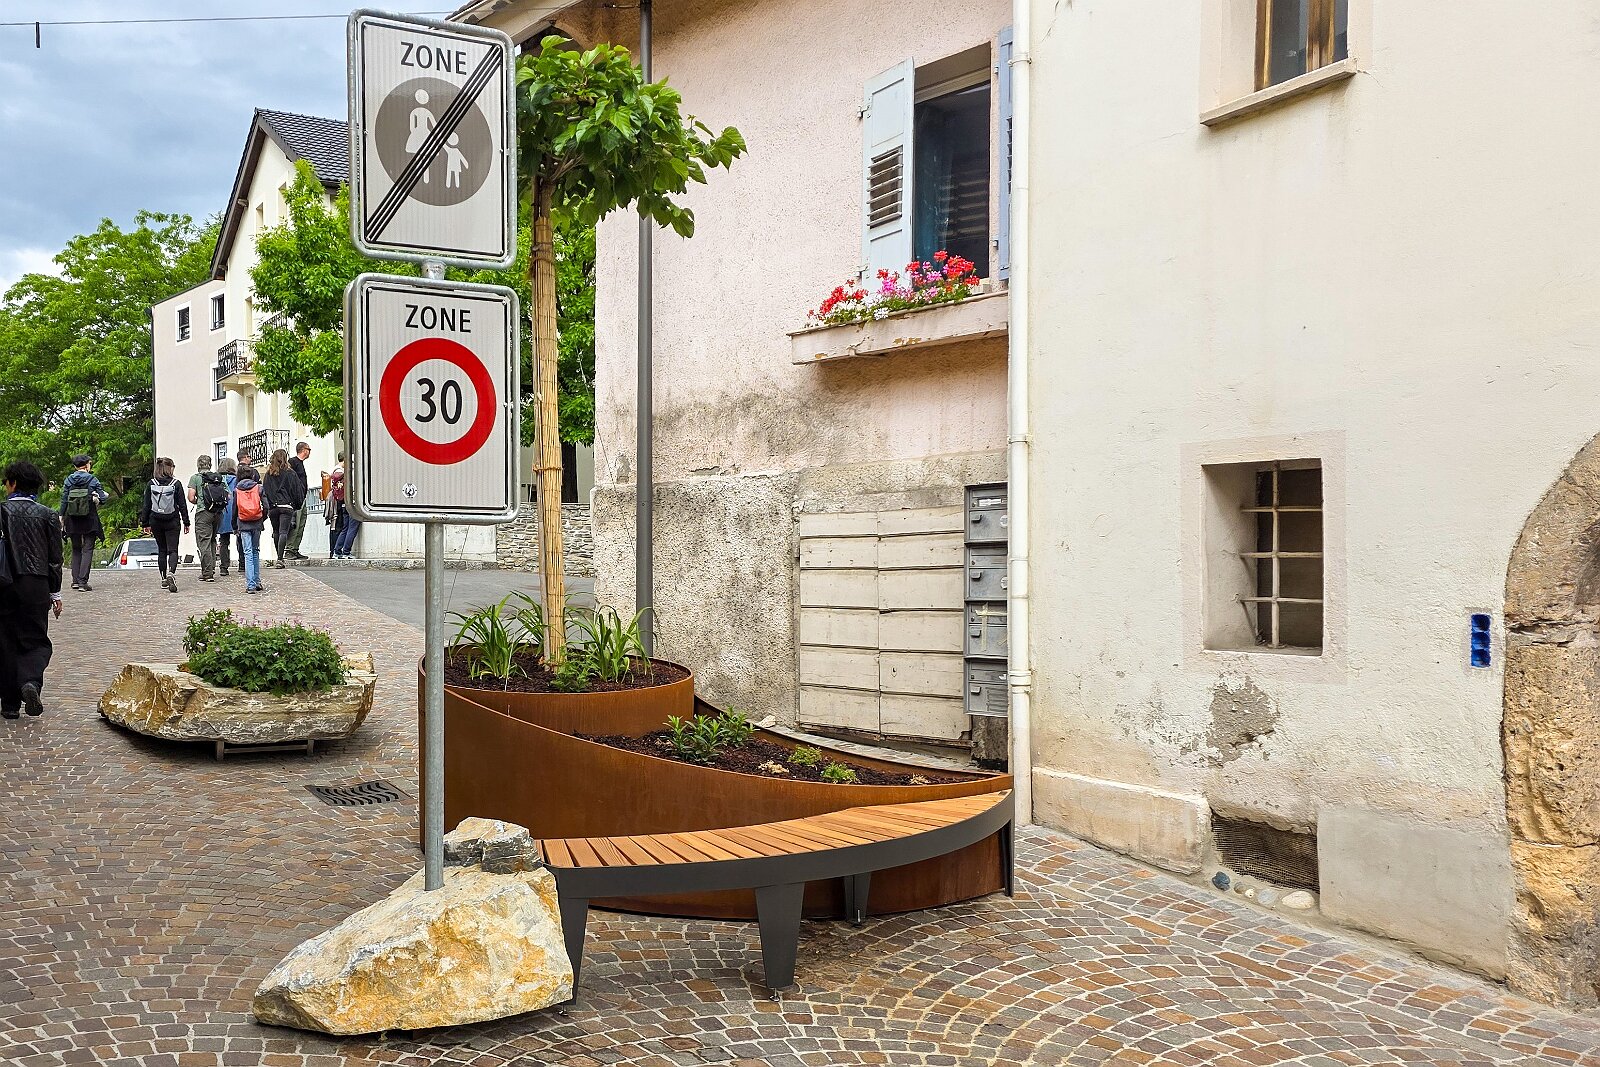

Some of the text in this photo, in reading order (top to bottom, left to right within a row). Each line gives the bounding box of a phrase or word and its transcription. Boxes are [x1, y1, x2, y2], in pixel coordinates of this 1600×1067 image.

[400, 41, 468, 76] ZONE
[405, 303, 472, 334] ZONE
[414, 377, 463, 425] 30
